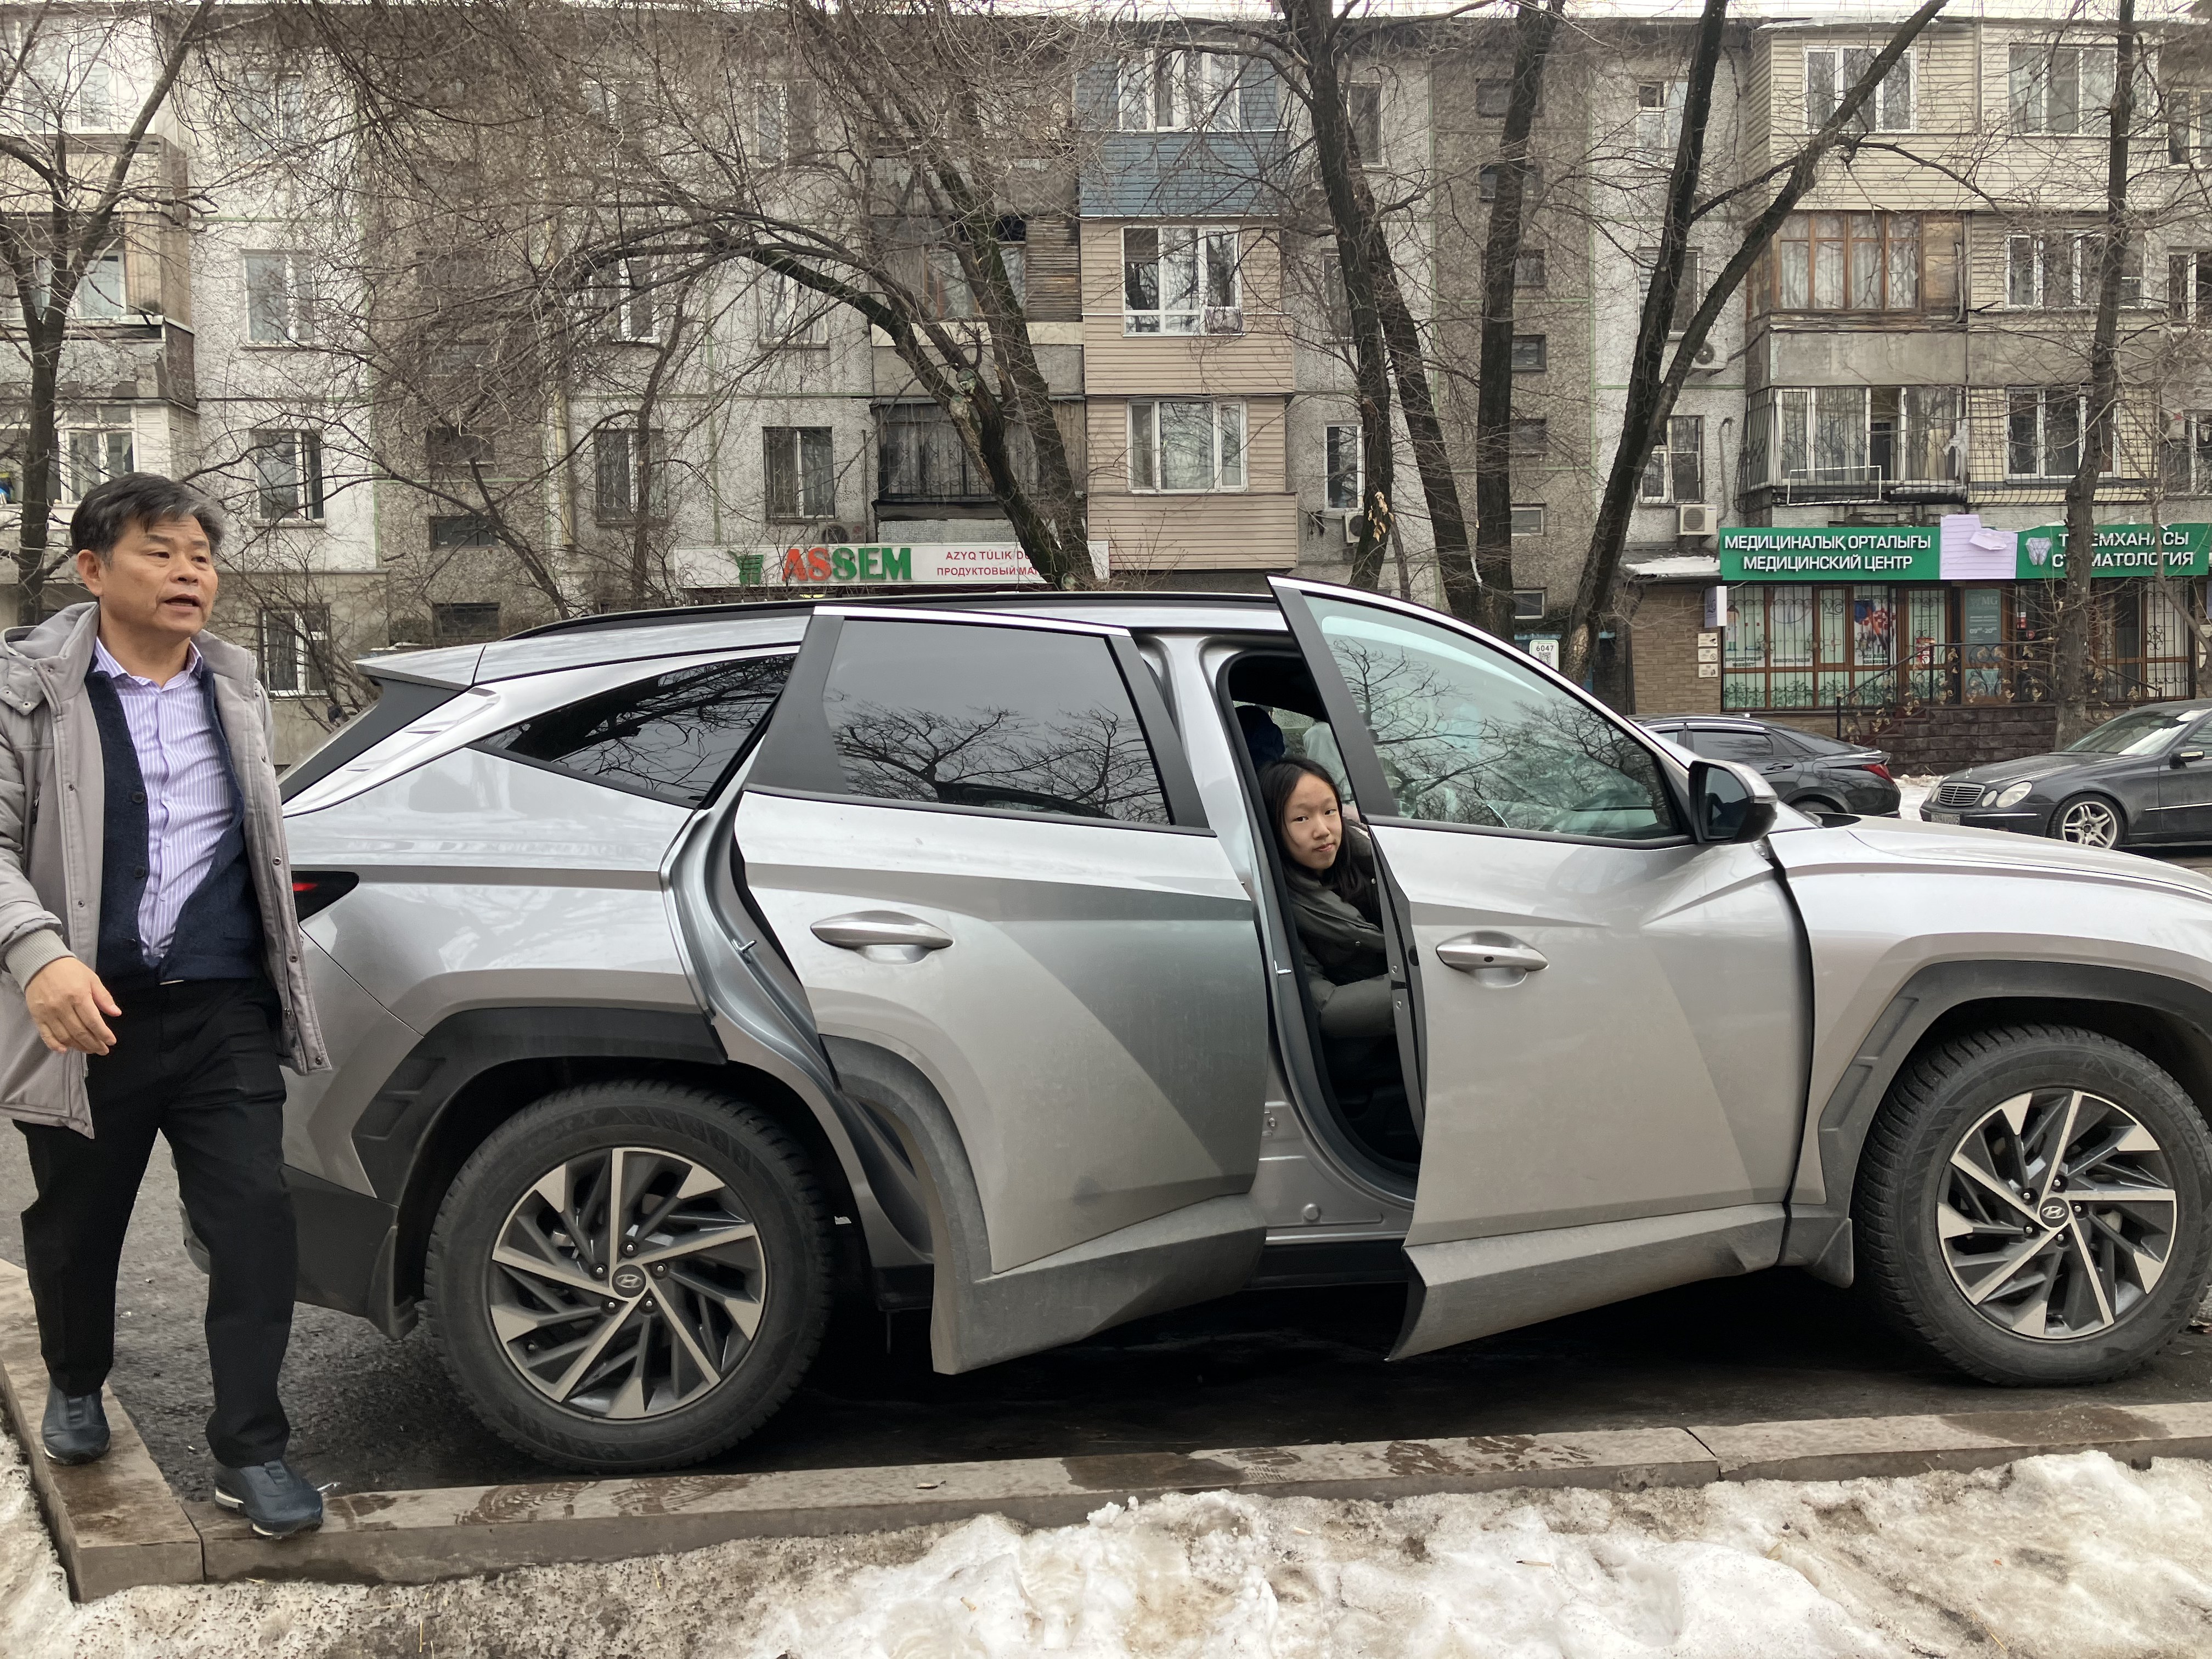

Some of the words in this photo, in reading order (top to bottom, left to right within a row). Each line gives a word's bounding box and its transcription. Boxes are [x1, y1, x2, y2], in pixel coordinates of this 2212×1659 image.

[1724, 535, 1846, 551] МЕДИЦИНАЛЫҚ
[1848, 535, 1931, 549] ОРТАЛЫҒЫ
[946, 551, 976, 560] AZYQ
[979, 549, 1012, 560] TÚLIK
[2052, 551, 2194, 567] СМАТОЛОГИЯ
[782, 548, 912, 582] ASSEM
[937, 565, 1015, 577] ПРОДУКТОВЫЙ
[1743, 554, 1861, 572] МЕДИЦИНСКИЙ
[1864, 555, 1912, 572] ЦЕНТР
